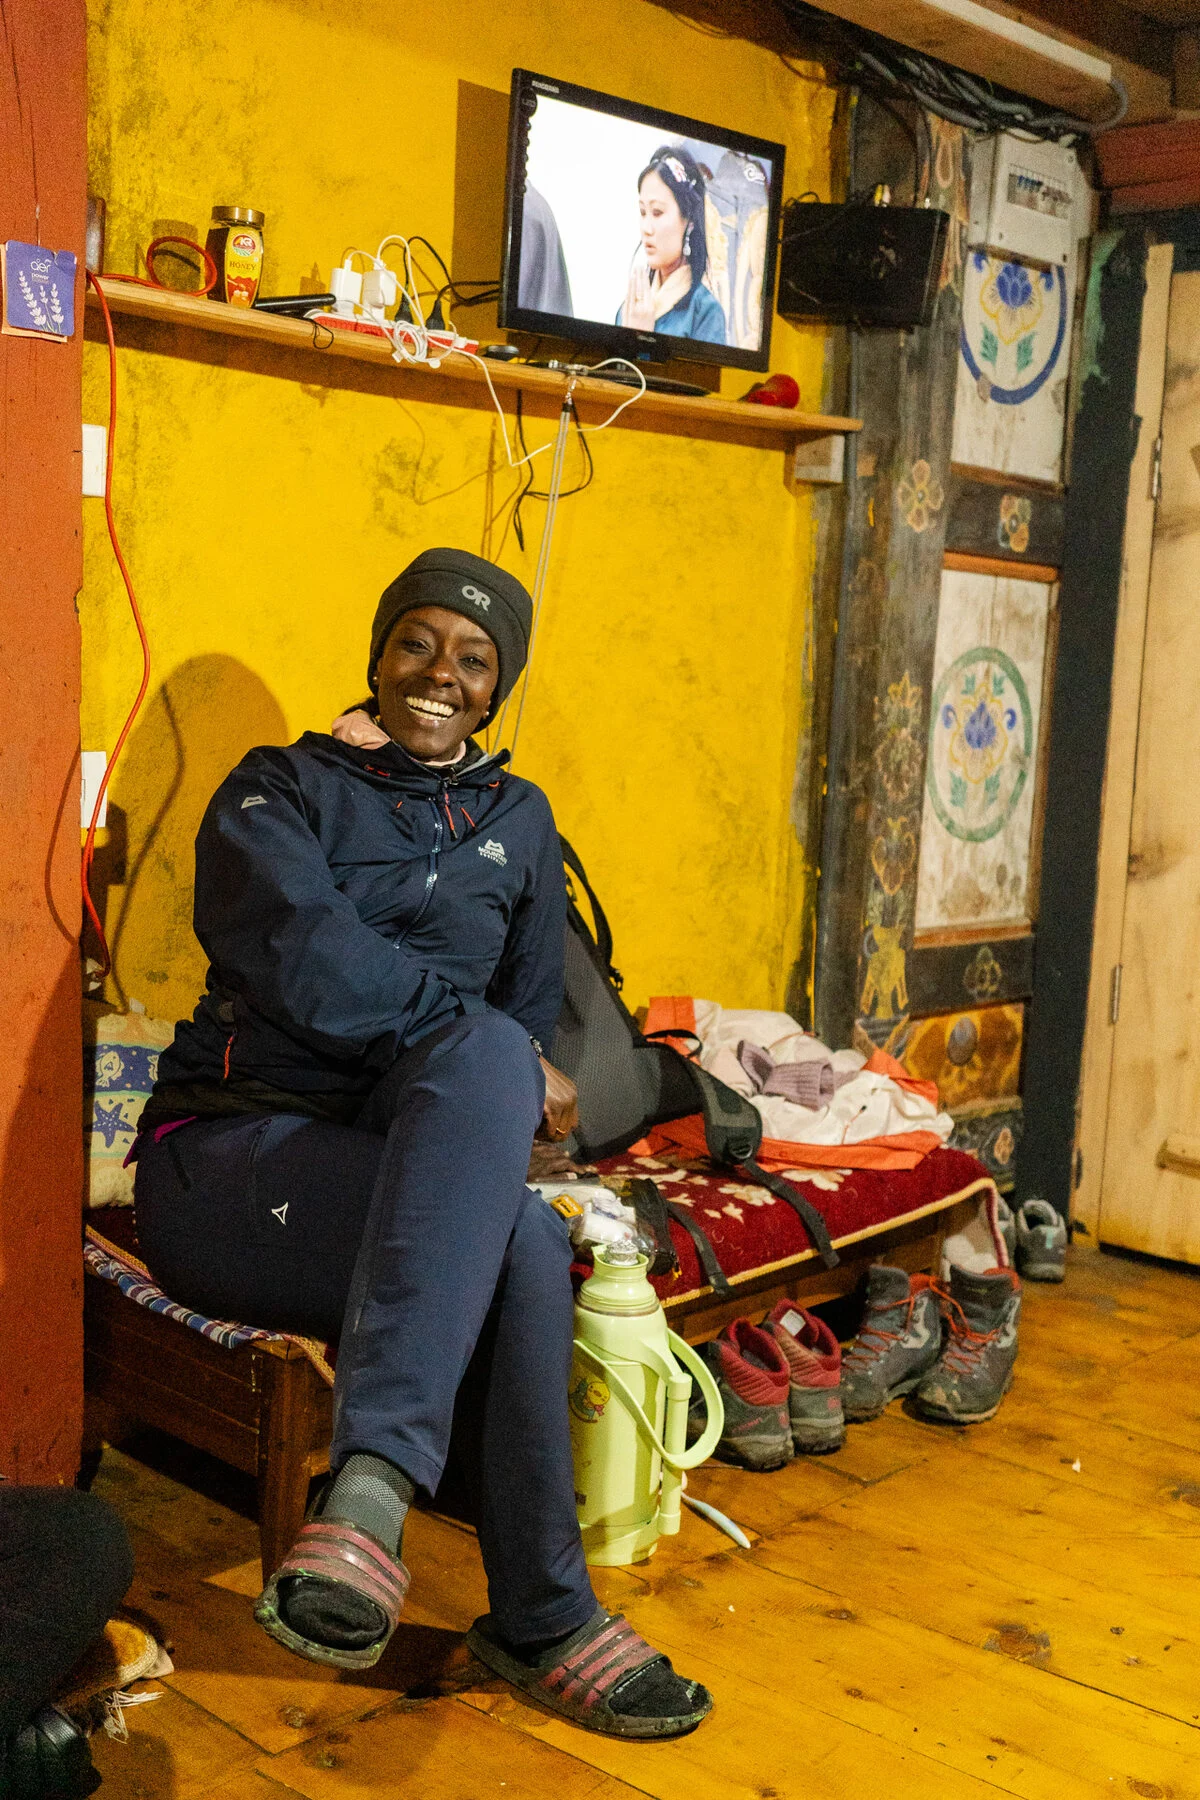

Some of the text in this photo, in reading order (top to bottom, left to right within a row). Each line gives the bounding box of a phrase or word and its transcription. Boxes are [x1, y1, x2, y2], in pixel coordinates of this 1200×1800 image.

[229, 261, 257, 271] HONEY
[32, 272, 49, 281] power
[461, 585, 491, 612] OR
[478, 846, 508, 865] MOUNTAIN
